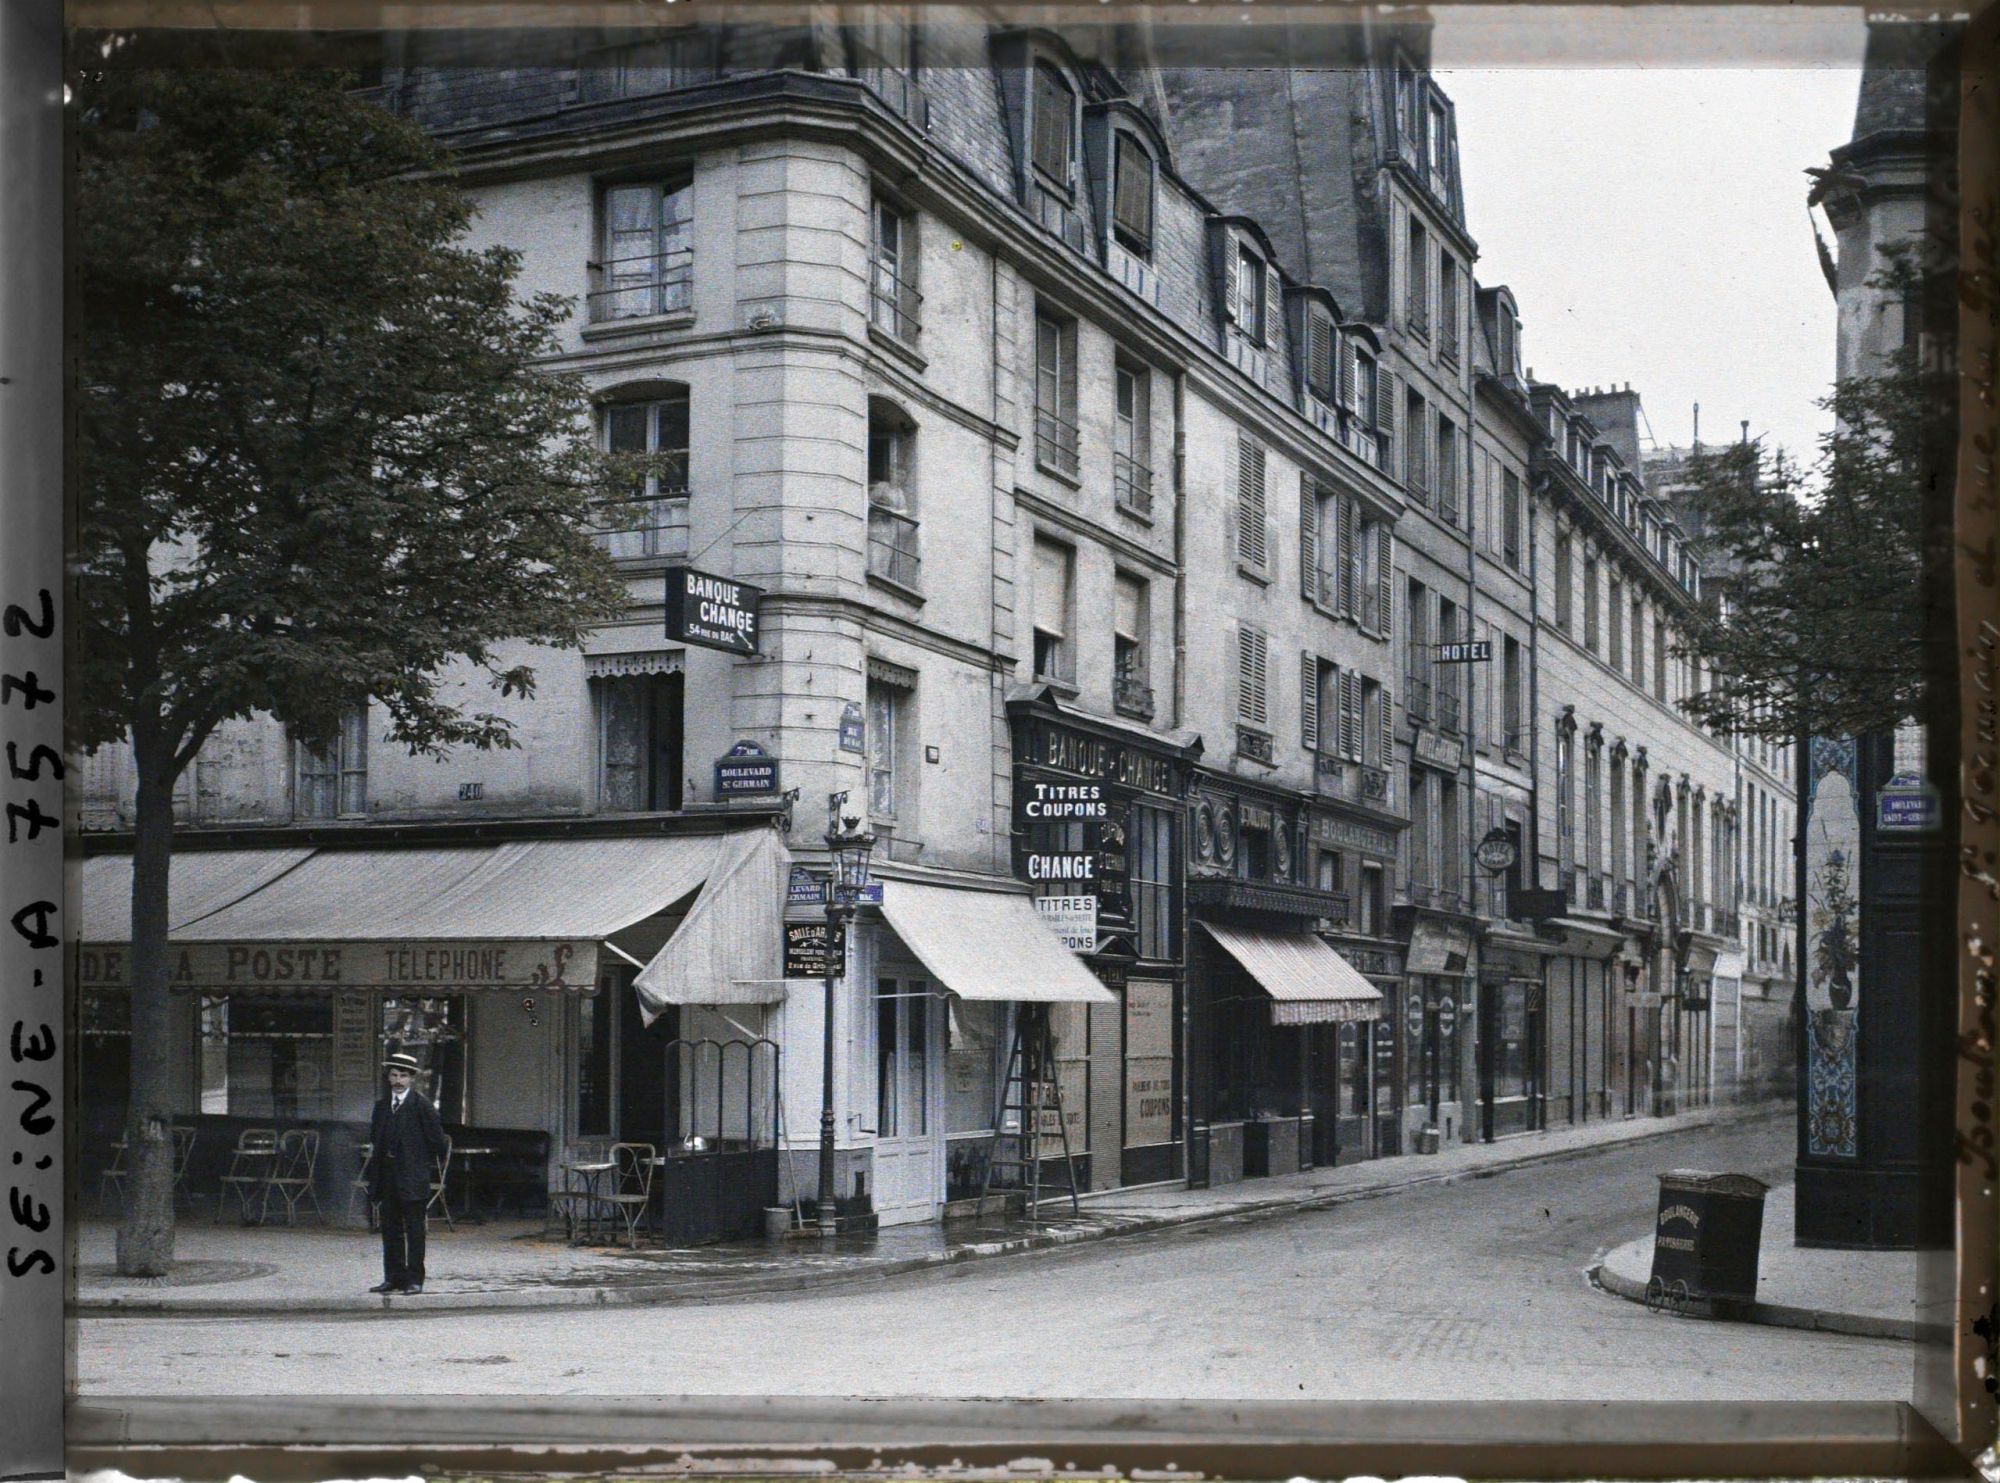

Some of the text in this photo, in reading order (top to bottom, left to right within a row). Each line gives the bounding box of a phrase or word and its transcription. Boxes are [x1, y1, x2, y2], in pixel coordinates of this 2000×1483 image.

[686, 573, 740, 606] BANQUE
[700, 601, 754, 632] CHANGE
[688, 623, 701, 635] 54
[720, 630, 735, 643] BAC
[1441, 644, 1489, 660] HOTEL
[1048, 730, 1168, 793] BANQUE CHANGE
[721, 767, 772, 777] BOULEVARD
[732, 779, 770, 788] GERMAIN
[1035, 783, 1100, 800] TITRES
[1026, 801, 1107, 817] COUPONS
[1028, 854, 1094, 879] CHANGE
[1038, 898, 1093, 911] TITRES
[789, 927, 811, 942] SALLE
[226, 946, 341, 982] POSTE
